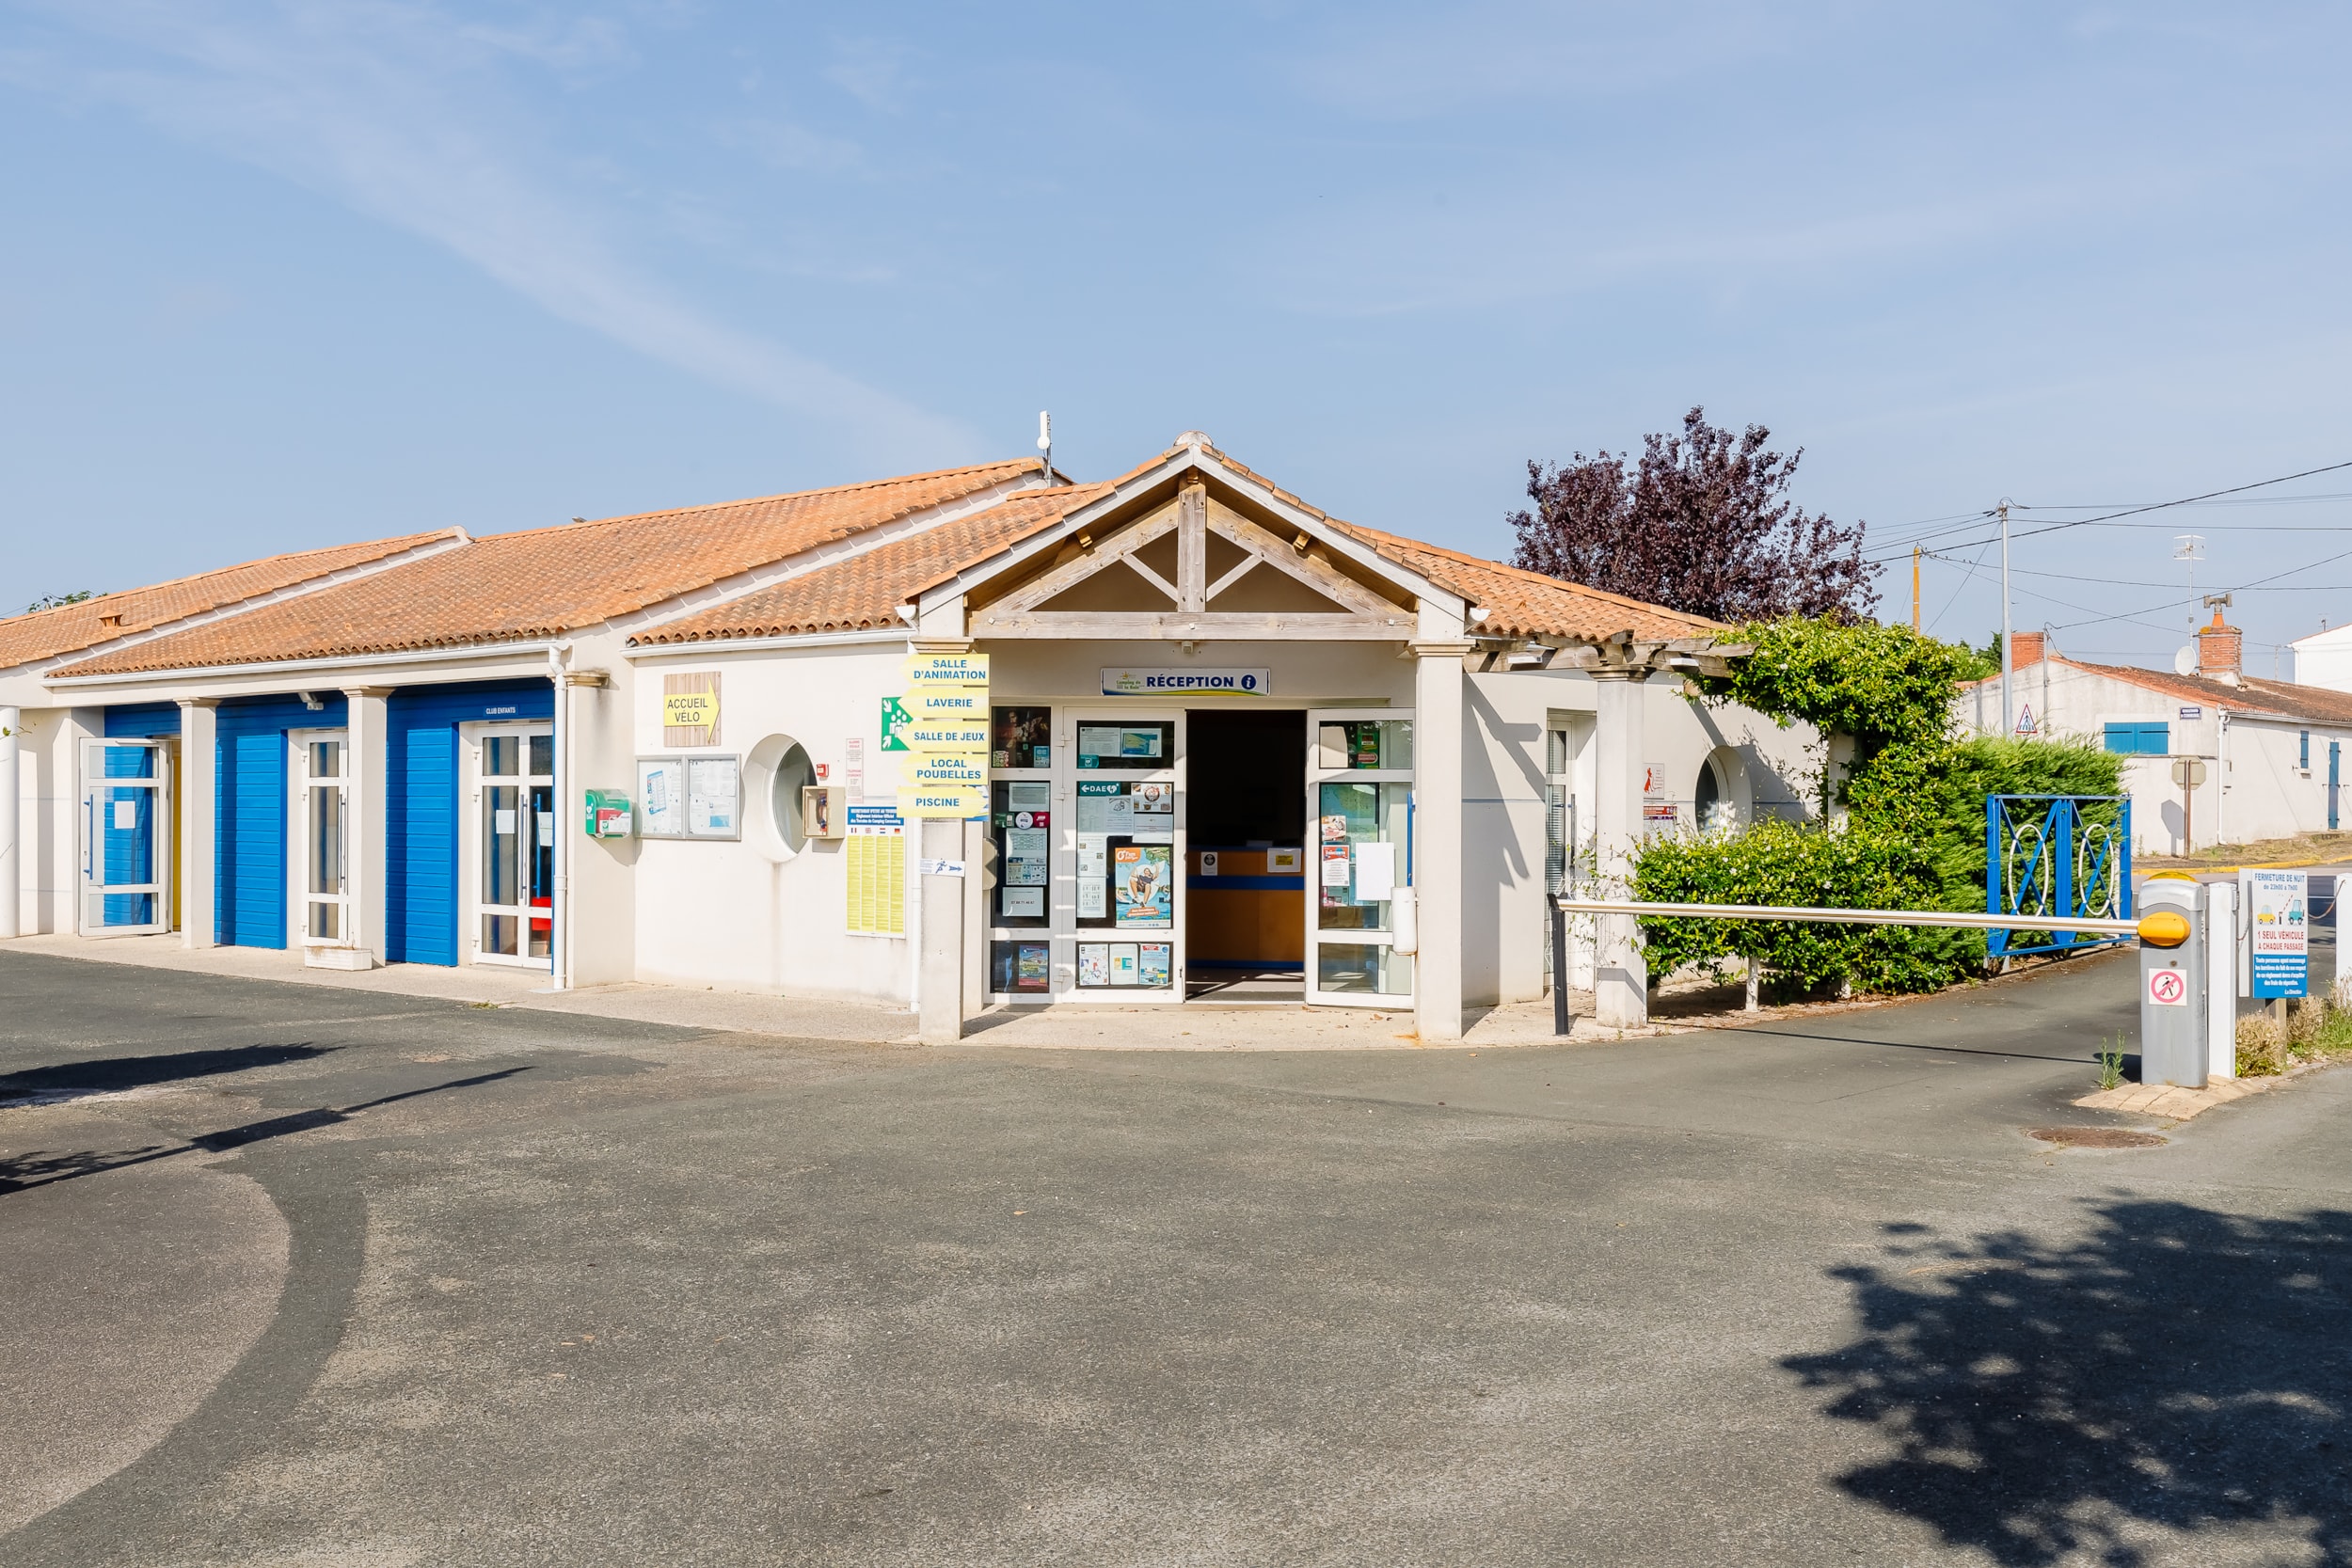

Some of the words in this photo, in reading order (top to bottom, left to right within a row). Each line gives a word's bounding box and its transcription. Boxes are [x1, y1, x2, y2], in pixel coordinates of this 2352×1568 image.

[932, 659, 967, 668] SALLE
[914, 671, 986, 679] D'ANIMATION
[1146, 673, 1234, 688] RÉCEPTION
[667, 698, 708, 709] ACCUEIL
[927, 699, 973, 707] LAVERIE
[675, 710, 700, 722] VÉLO
[914, 733, 943, 741] SALLE
[946, 733, 958, 741] DE
[961, 733, 985, 741] JEUX
[931, 759, 967, 768] LOCAL
[916, 769, 981, 780] POUBELLES
[915, 798, 960, 807] PISCINE
[2254, 873, 2285, 882] FERMETURE
[2294, 875, 2305, 883] NUIT
[2258, 930, 2261, 940] 1
[2262, 930, 2277, 940] SEUL
